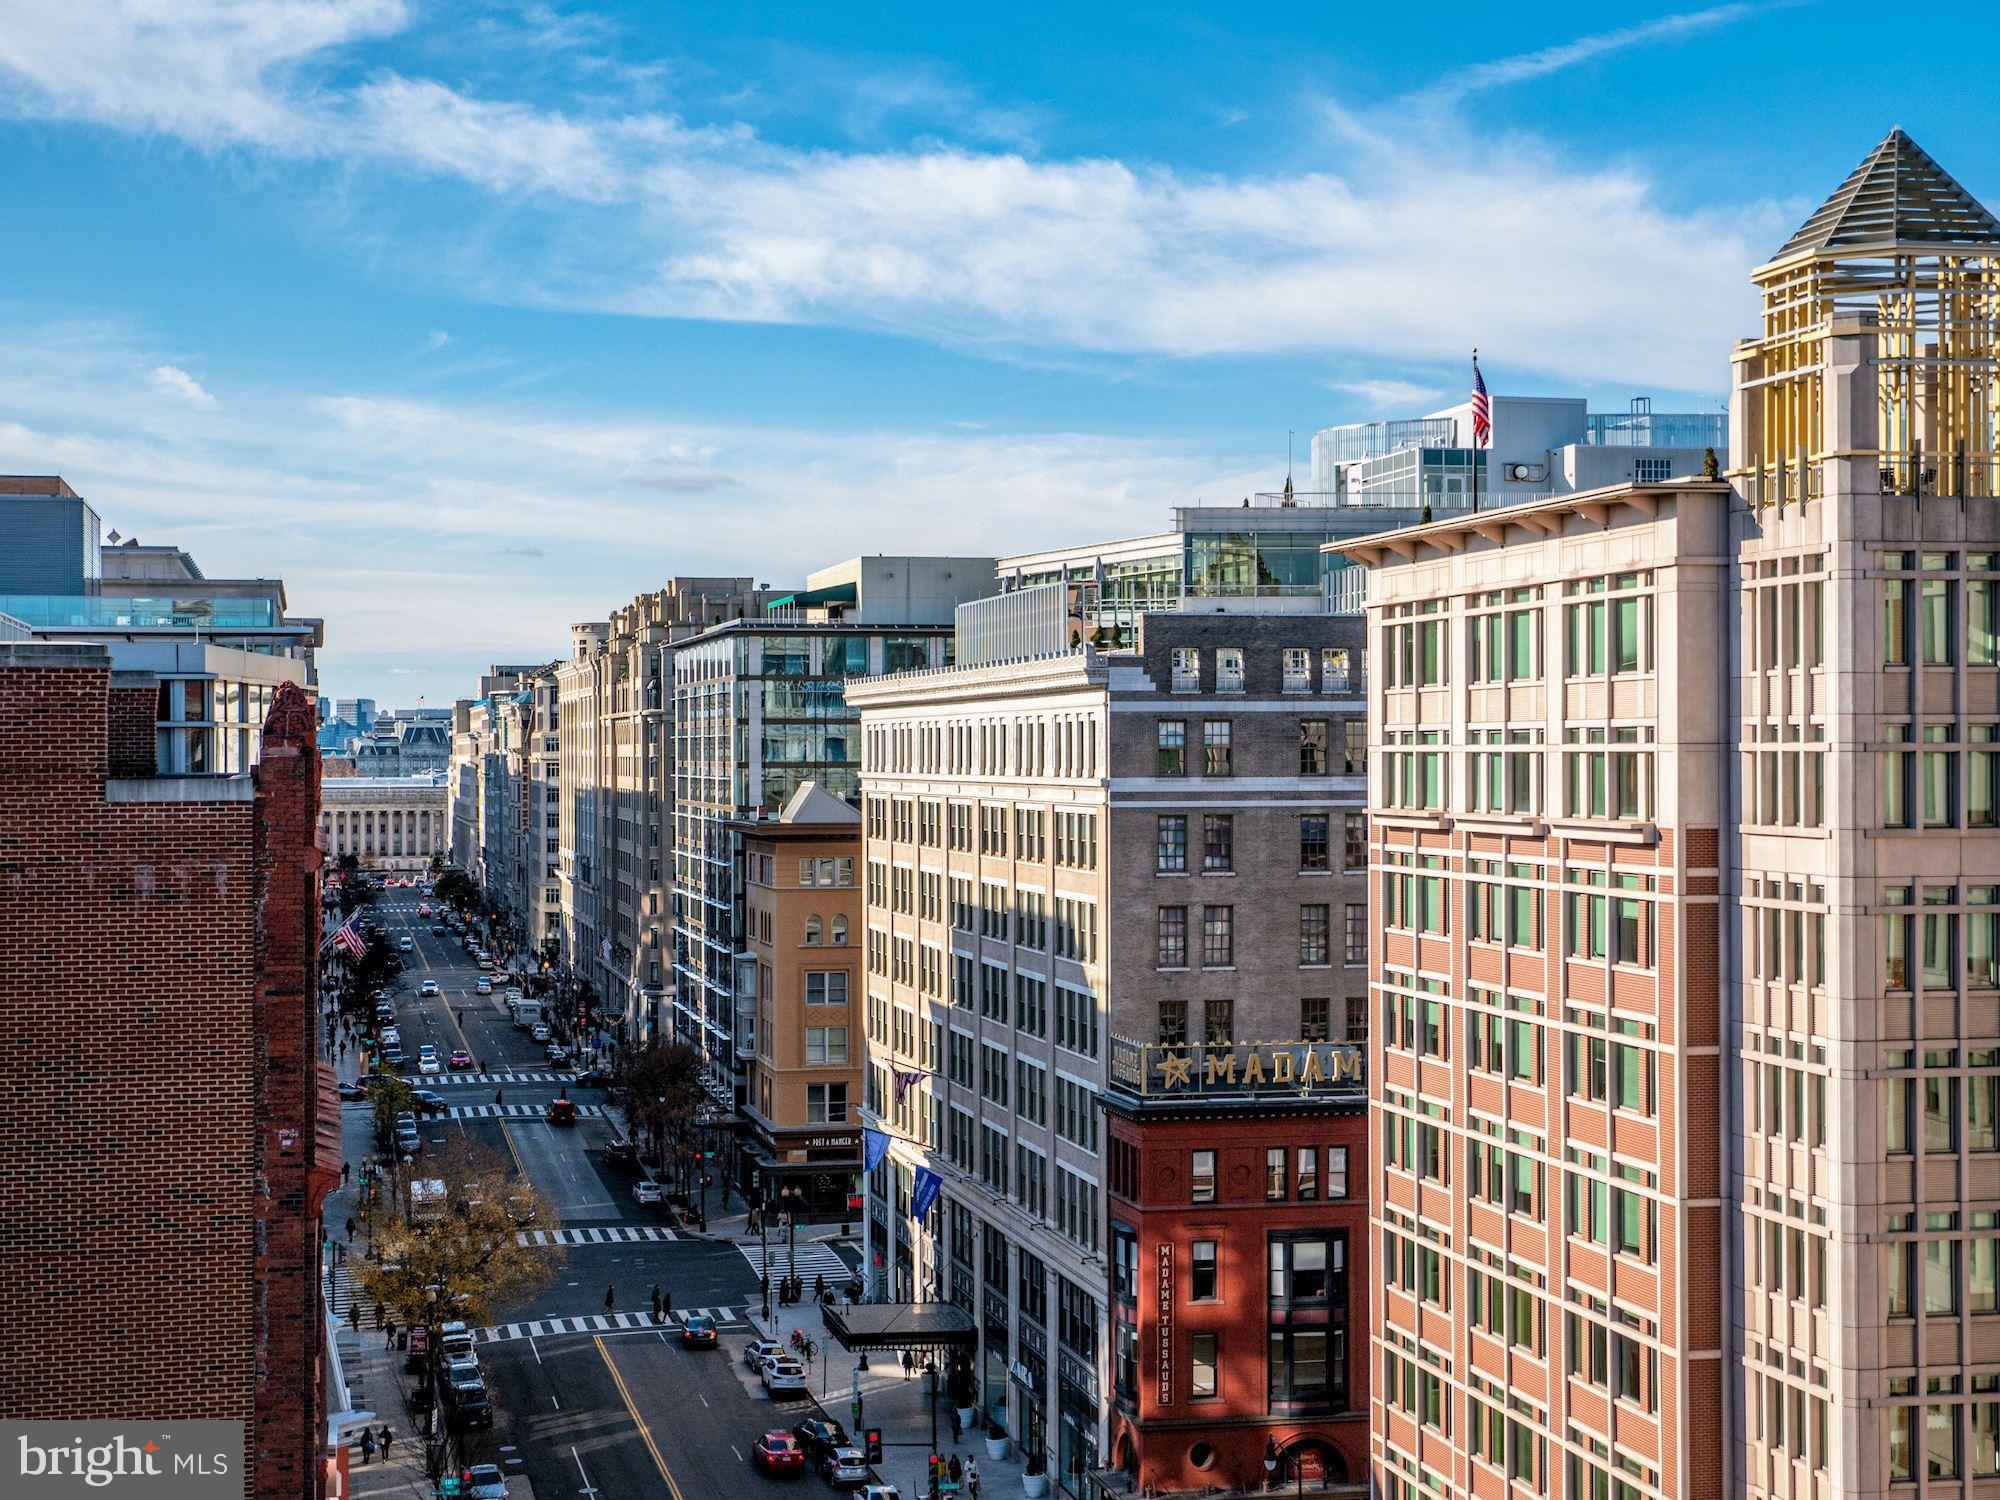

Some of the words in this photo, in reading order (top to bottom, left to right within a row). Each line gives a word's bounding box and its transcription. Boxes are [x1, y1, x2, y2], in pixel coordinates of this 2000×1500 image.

[1206, 1051, 1362, 1085] MADAM
[1161, 1246, 1170, 1311] MADAME
[1010, 1357, 1034, 1390] ZARA
[1161, 1316, 1170, 1403] TUSSAUDS
